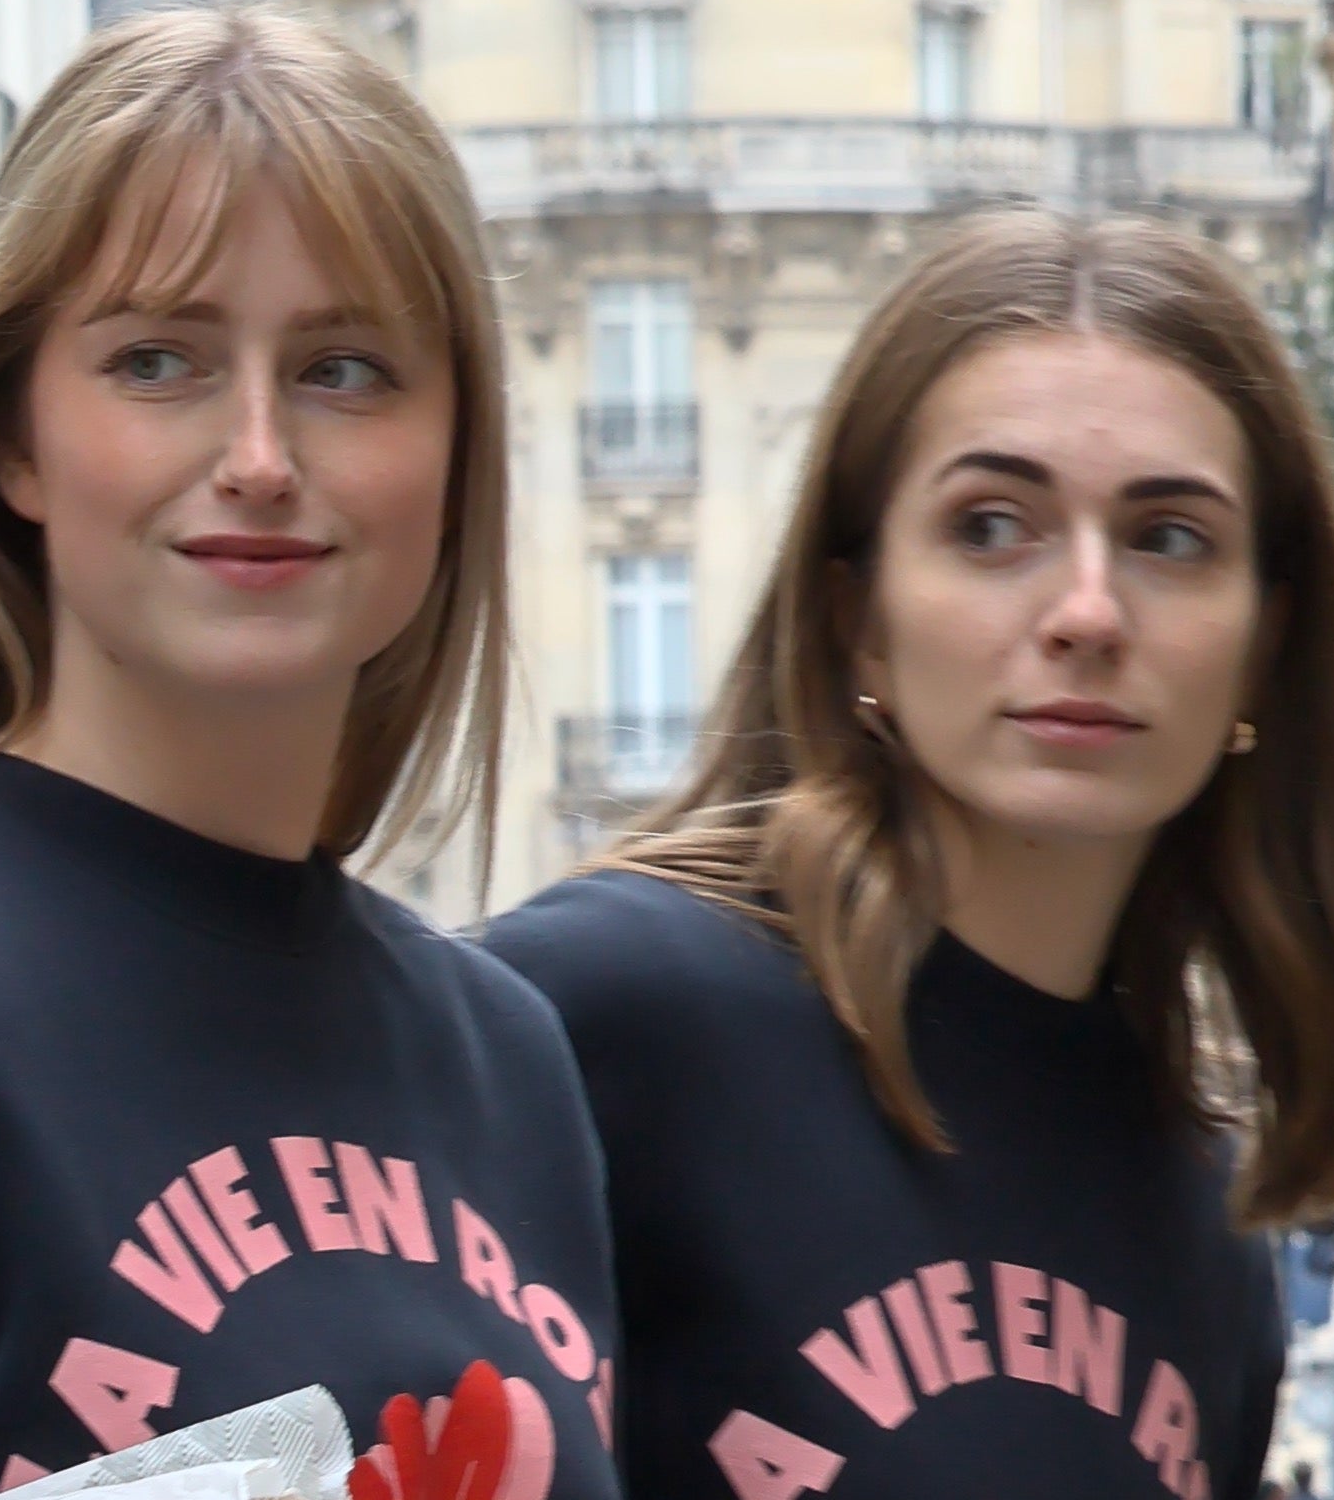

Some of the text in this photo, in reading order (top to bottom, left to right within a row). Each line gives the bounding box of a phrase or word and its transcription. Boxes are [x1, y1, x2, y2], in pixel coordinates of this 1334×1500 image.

[110, 1145, 293, 1334] VIE
[270, 1135, 438, 1263] EN
[798, 1259, 995, 1430] VIE
[991, 1260, 1128, 1417] EN
